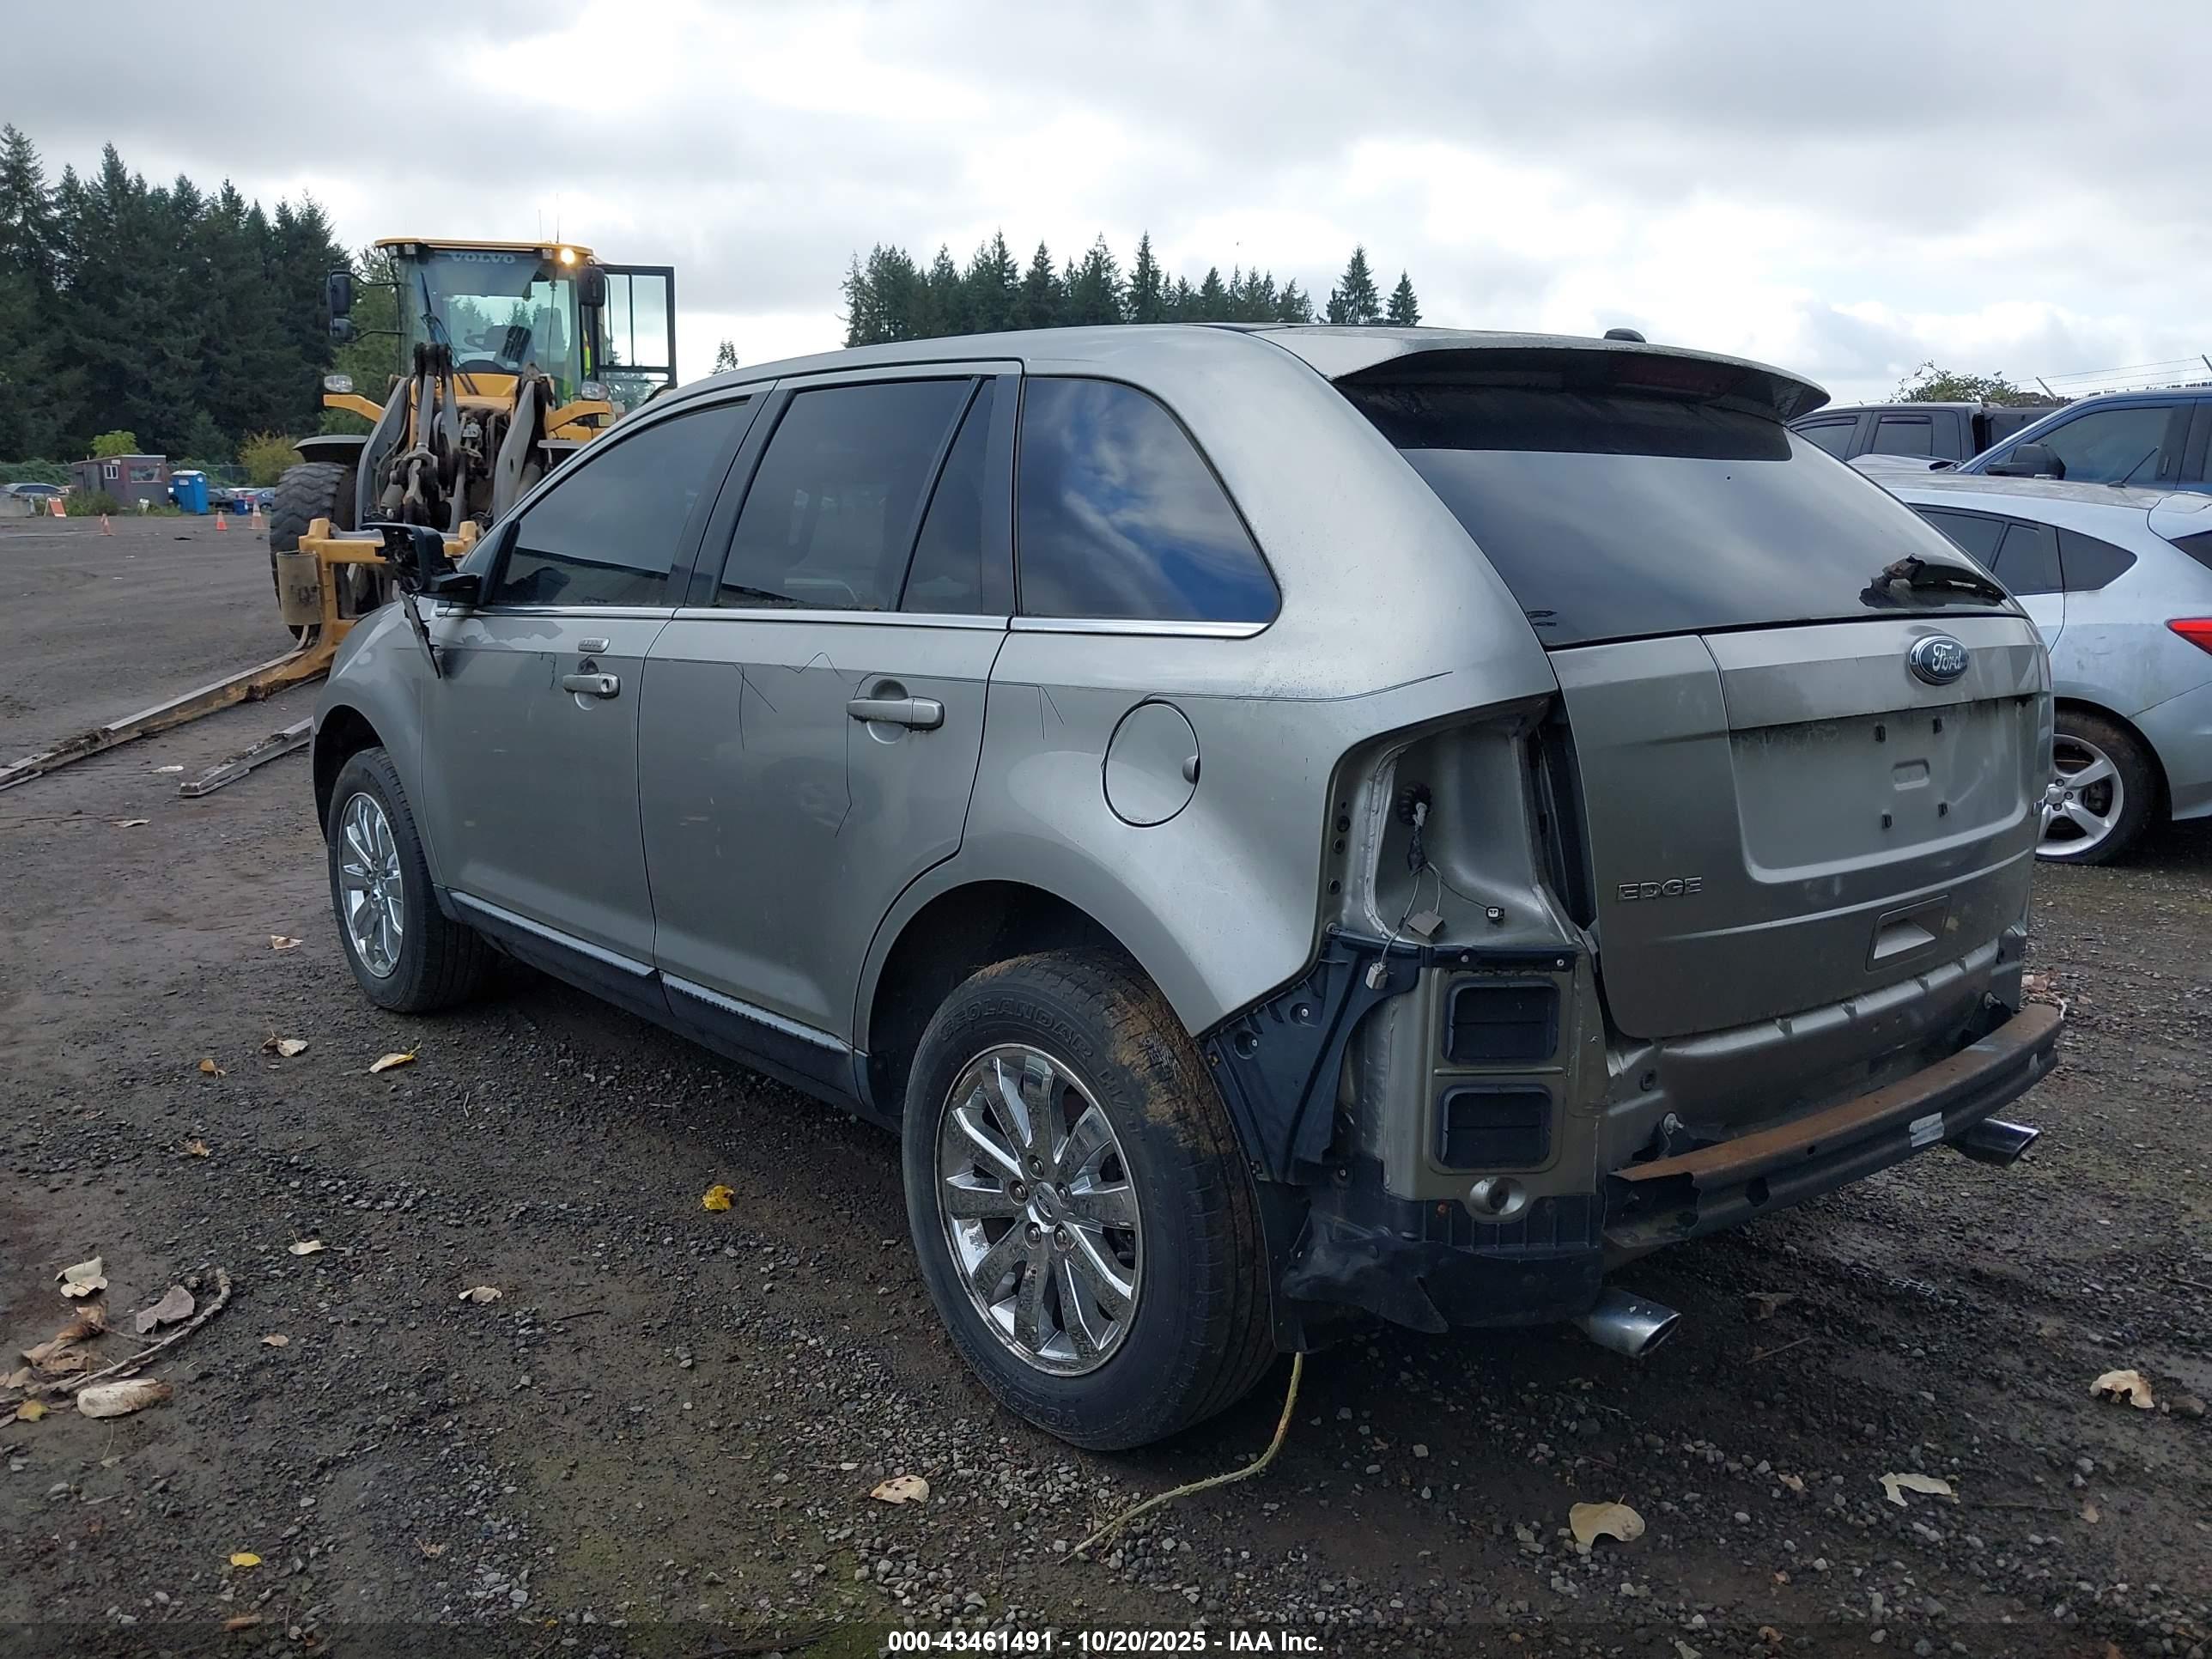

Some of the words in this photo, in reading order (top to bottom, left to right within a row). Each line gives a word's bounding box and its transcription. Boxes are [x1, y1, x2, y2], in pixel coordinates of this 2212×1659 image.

[448, 252, 516, 264] VOLVO
[1932, 643, 1962, 672] Ford
[1617, 877, 1703, 900] EDGE
